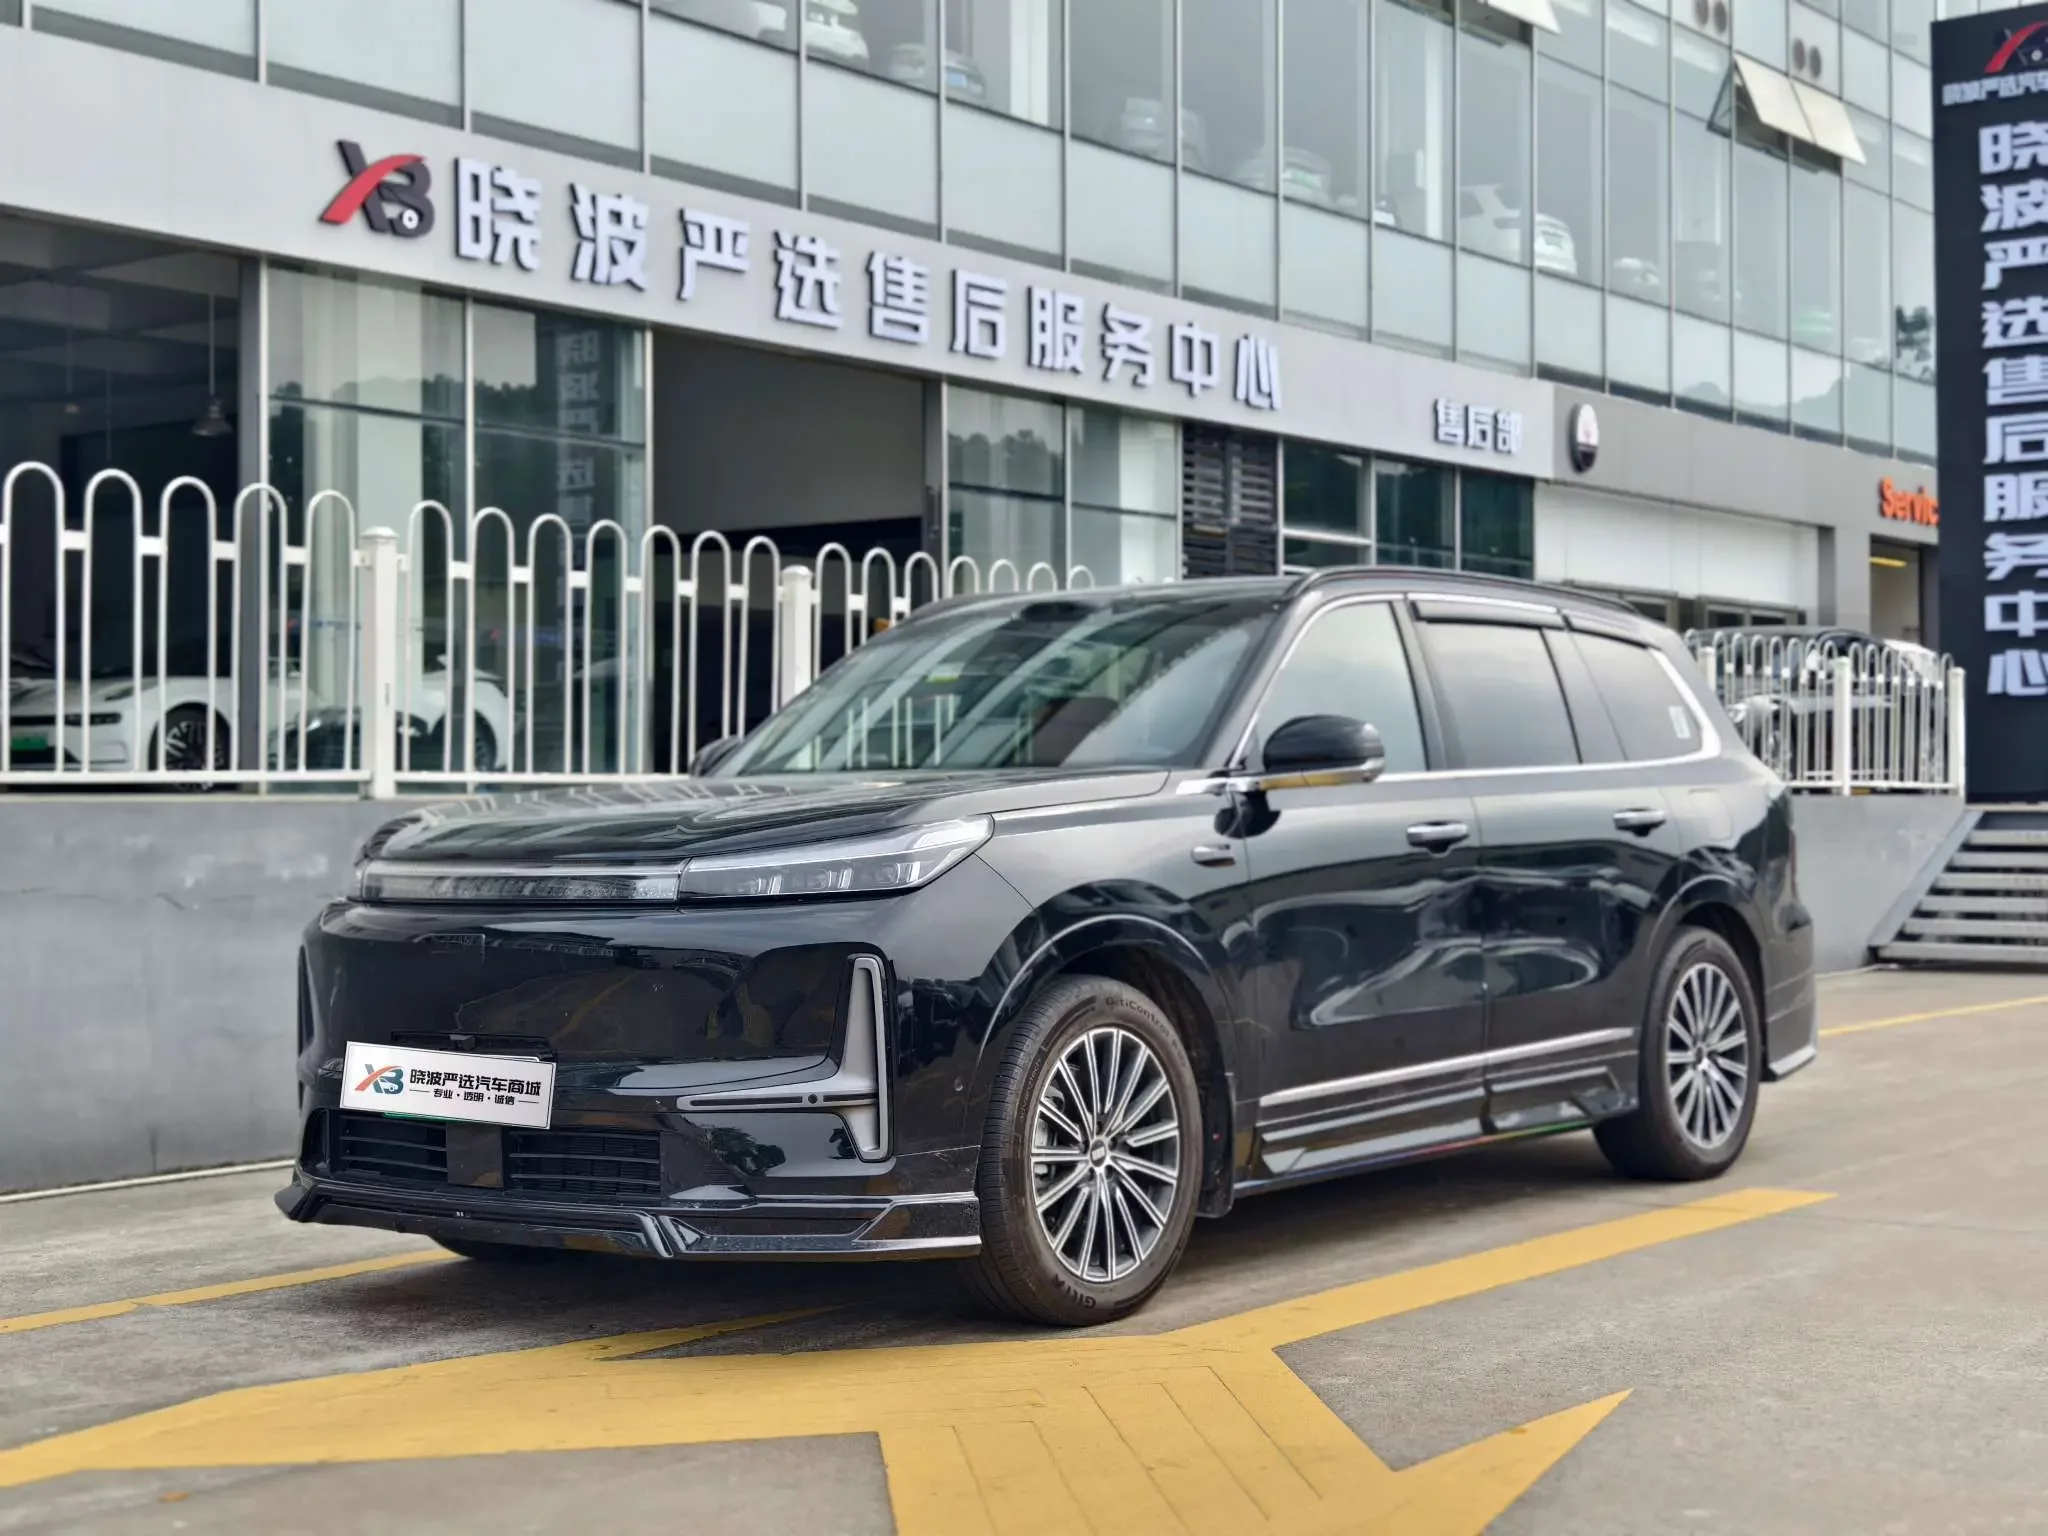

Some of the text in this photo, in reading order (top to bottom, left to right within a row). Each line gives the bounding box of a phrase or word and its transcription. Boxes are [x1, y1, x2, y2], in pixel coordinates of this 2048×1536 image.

[453, 156, 1282, 411] 晓波严选售后服务中心
[1434, 398, 1523, 454] 售后部
[1978, 120, 2048, 697] 晓波严选售后服务中心
[1878, 477, 1941, 528] Servic
[409, 1068, 541, 1096] 晓波严选汽车商城
